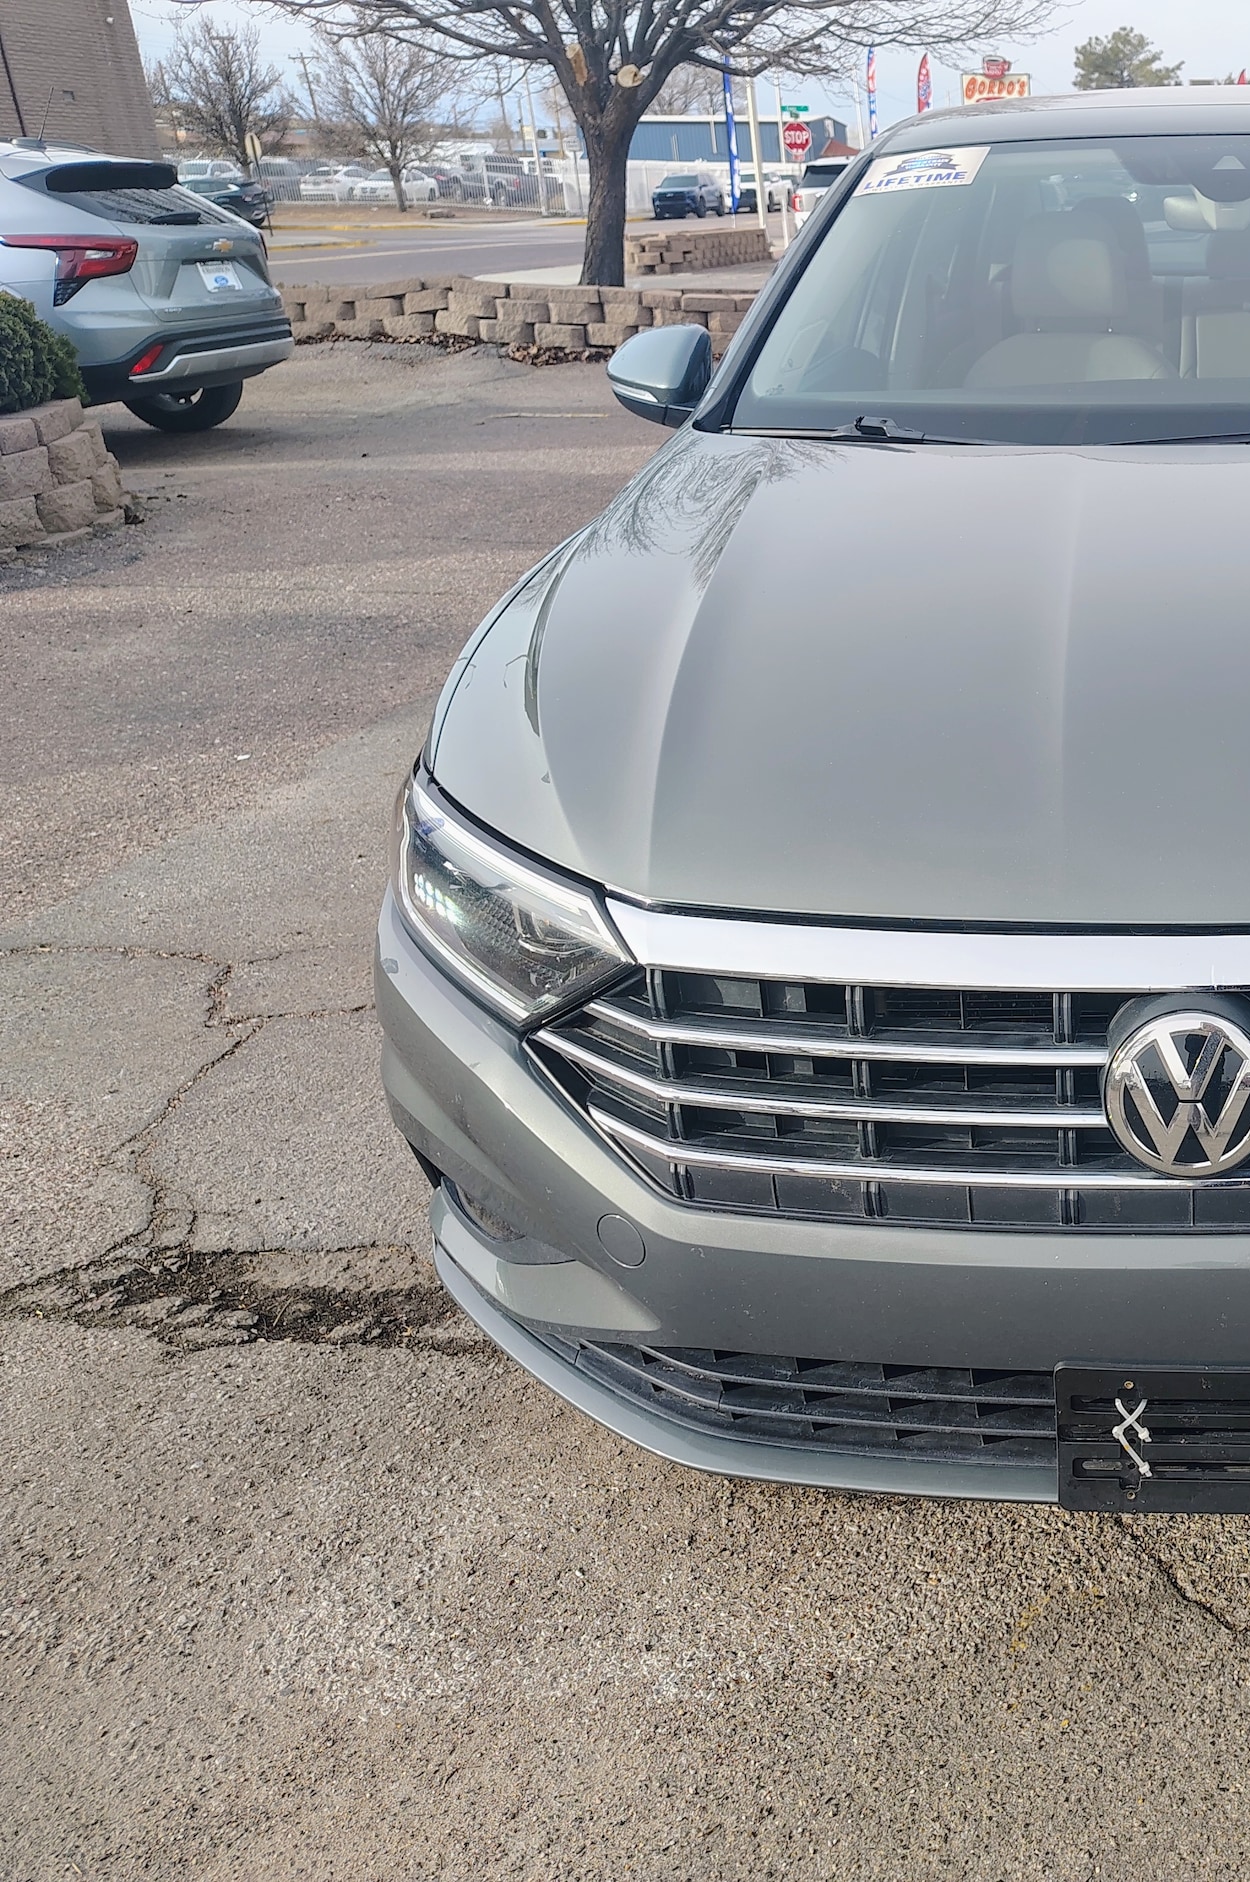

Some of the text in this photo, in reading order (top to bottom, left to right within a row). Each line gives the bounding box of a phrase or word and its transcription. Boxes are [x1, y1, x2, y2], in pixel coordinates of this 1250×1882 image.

[965, 76, 1026, 99] GORDO'S
[784, 130, 809, 145] STOP
[863, 171, 968, 190] LIFETIME
